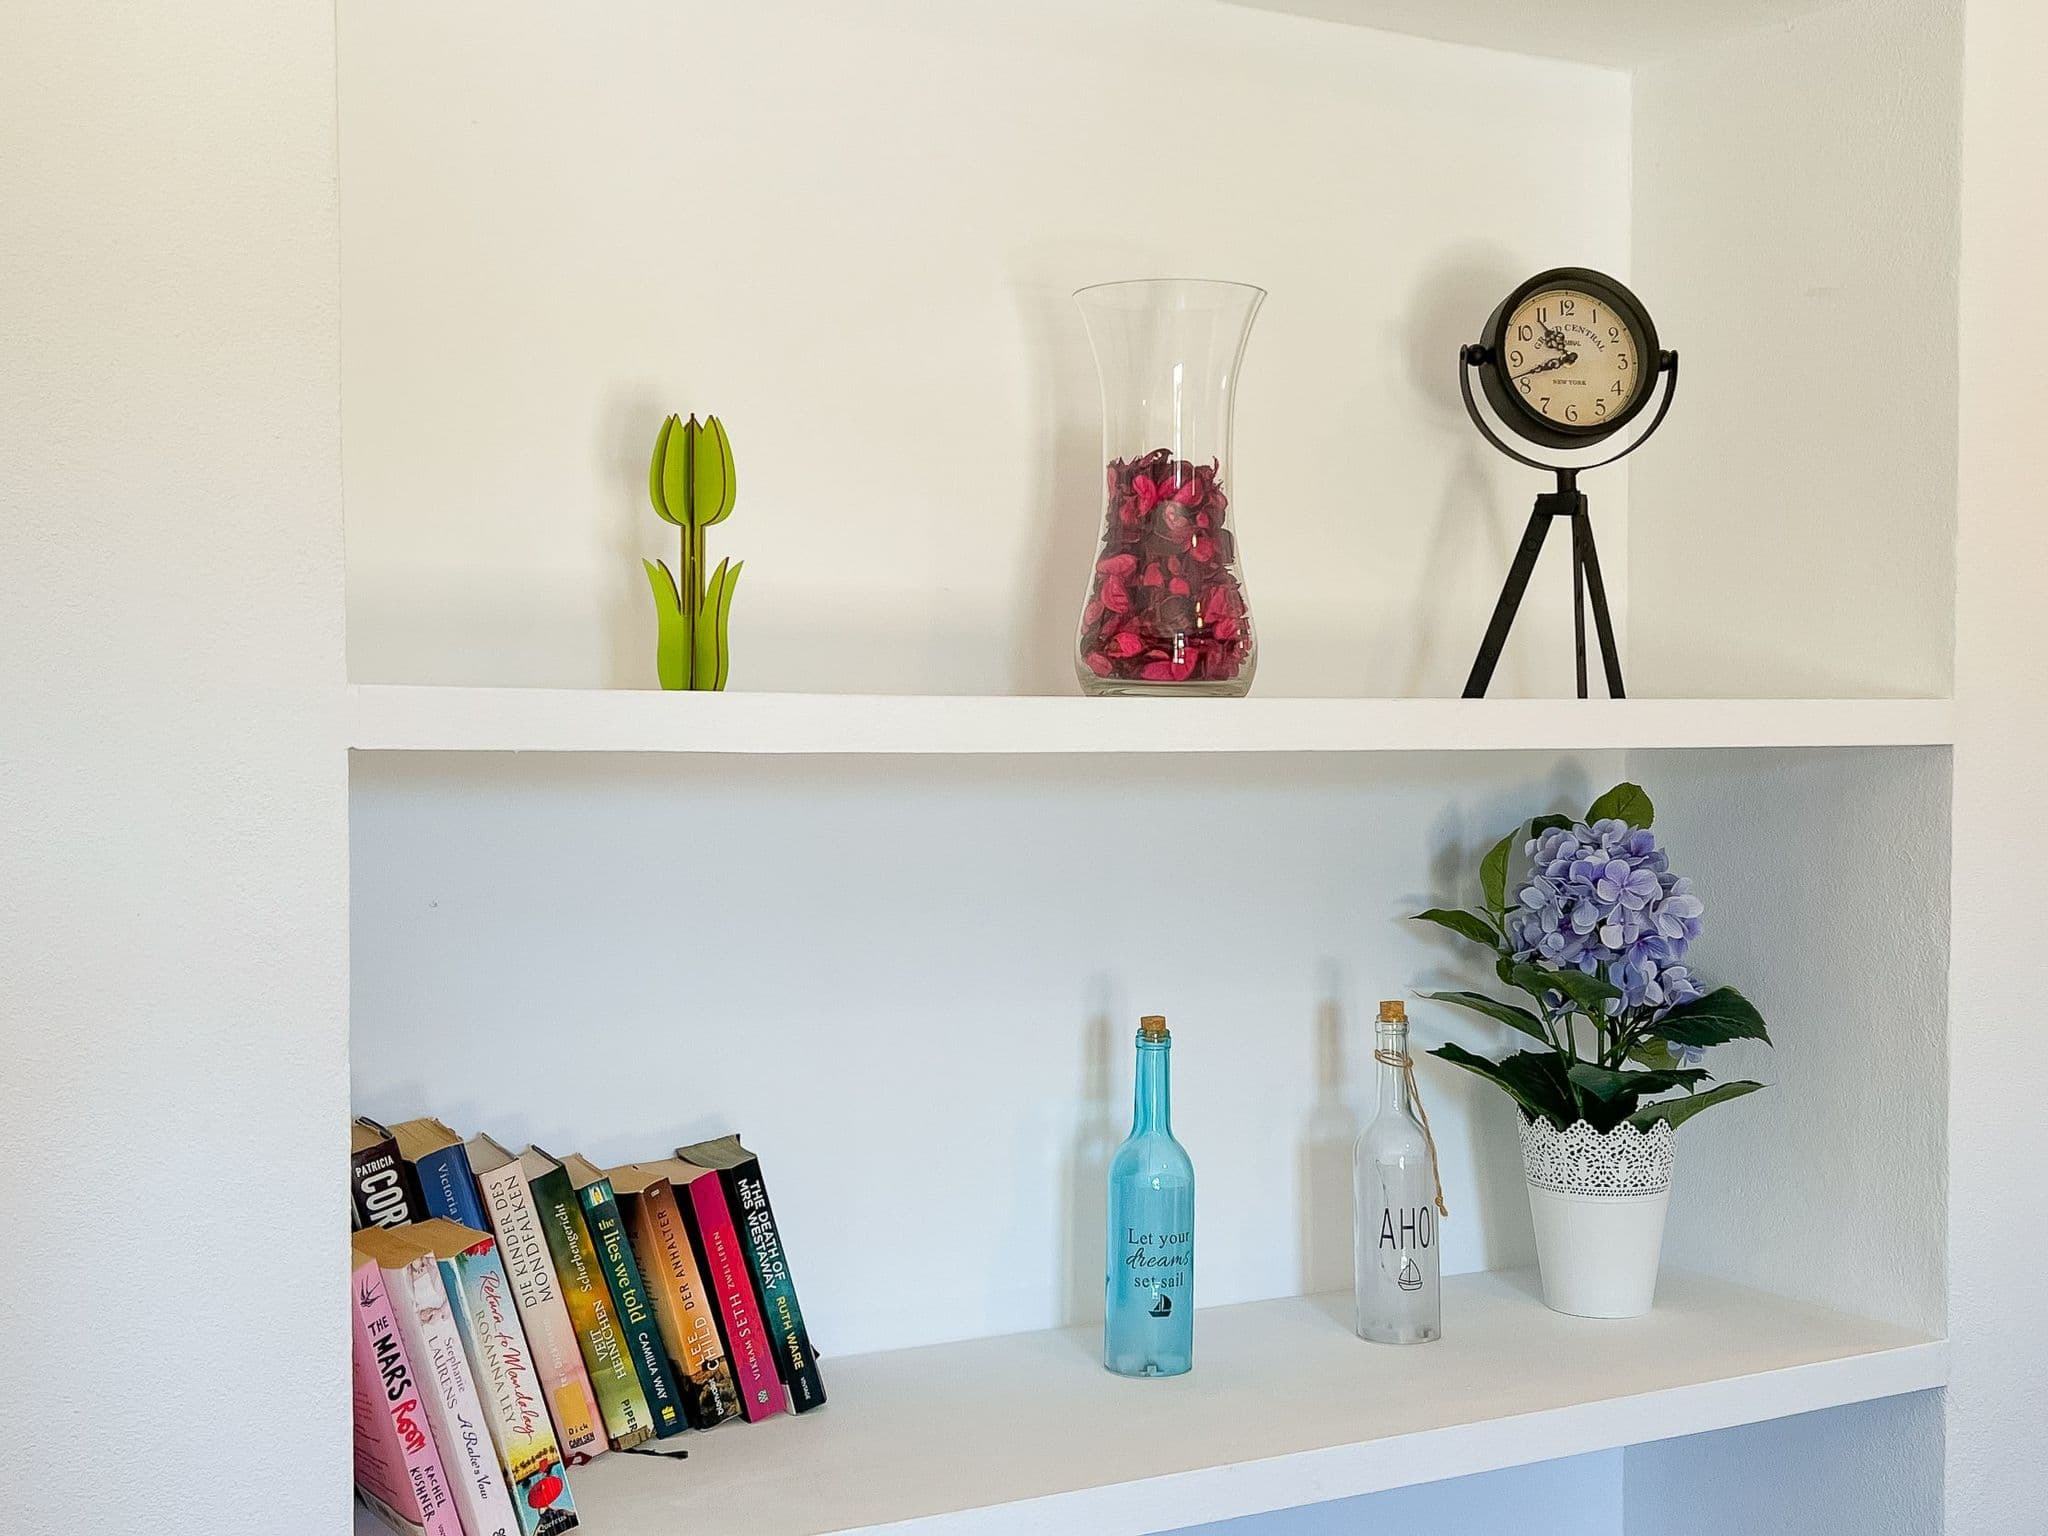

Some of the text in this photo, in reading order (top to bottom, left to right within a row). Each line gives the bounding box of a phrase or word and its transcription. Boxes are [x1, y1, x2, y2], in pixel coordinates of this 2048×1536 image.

[1537, 307, 1546, 323] 11
[1560, 300, 1575, 316] 12
[1592, 309, 1597, 324] 1
[1518, 325, 1533, 341] 10
[1534, 324, 1605, 352] GRND CENTRAL
[1608, 327, 1619, 343] 2
[1510, 351, 1523, 367] 9
[1617, 353, 1628, 370] 3
[1520, 378, 1531, 394] 8
[1610, 380, 1624, 396] 4
[1540, 397, 1550, 414] 7
[1565, 405, 1578, 422] 6
[1595, 399, 1606, 416] 5
[355, 1154, 395, 1178] PATRICIA
[360, 1169, 412, 1230] COR
[438, 1162, 460, 1215] Victoria
[489, 1181, 538, 1308] DIE KINDER DES
[504, 1175, 554, 1302] MONDFALKEN
[554, 1203, 592, 1293] Scherbengericht
[738, 1178, 777, 1289] MRS WESTAWAY
[749, 1180, 786, 1281] THE DEATH OF
[1128, 1228, 1190, 1249] Let your
[598, 1218, 647, 1324] the lies we told
[713, 1231, 735, 1289] ZWEI LEBEN
[1126, 1247, 1190, 1269] dreams
[679, 1282, 695, 1312] DER
[1134, 1272, 1184, 1288] set sail
[367, 1315, 389, 1337] THE
[592, 1300, 627, 1380] HEINICHEN
[694, 1317, 720, 1371] CHILD
[729, 1293, 761, 1381] VIKRAM SETH
[776, 1296, 804, 1371] RUTH WARE
[480, 1270, 539, 1445] Return to Mandalay
[590, 1329, 609, 1362] VEIT
[687, 1331, 705, 1368] LEE
[372, 1333, 412, 1401] MARS
[428, 1335, 458, 1410] LAURENS
[444, 1337, 465, 1392] Stephanie
[475, 1310, 516, 1423] ROSANNA LEY
[638, 1332, 668, 1399] CAMILLA WAY
[568, 1423, 589, 1436] Dick
[621, 1399, 638, 1432] PIPER
[457, 1413, 491, 1499] A Rake's Vow
[409, 1466, 435, 1522] KUSHNER
[424, 1465, 447, 1508] RACHEL
